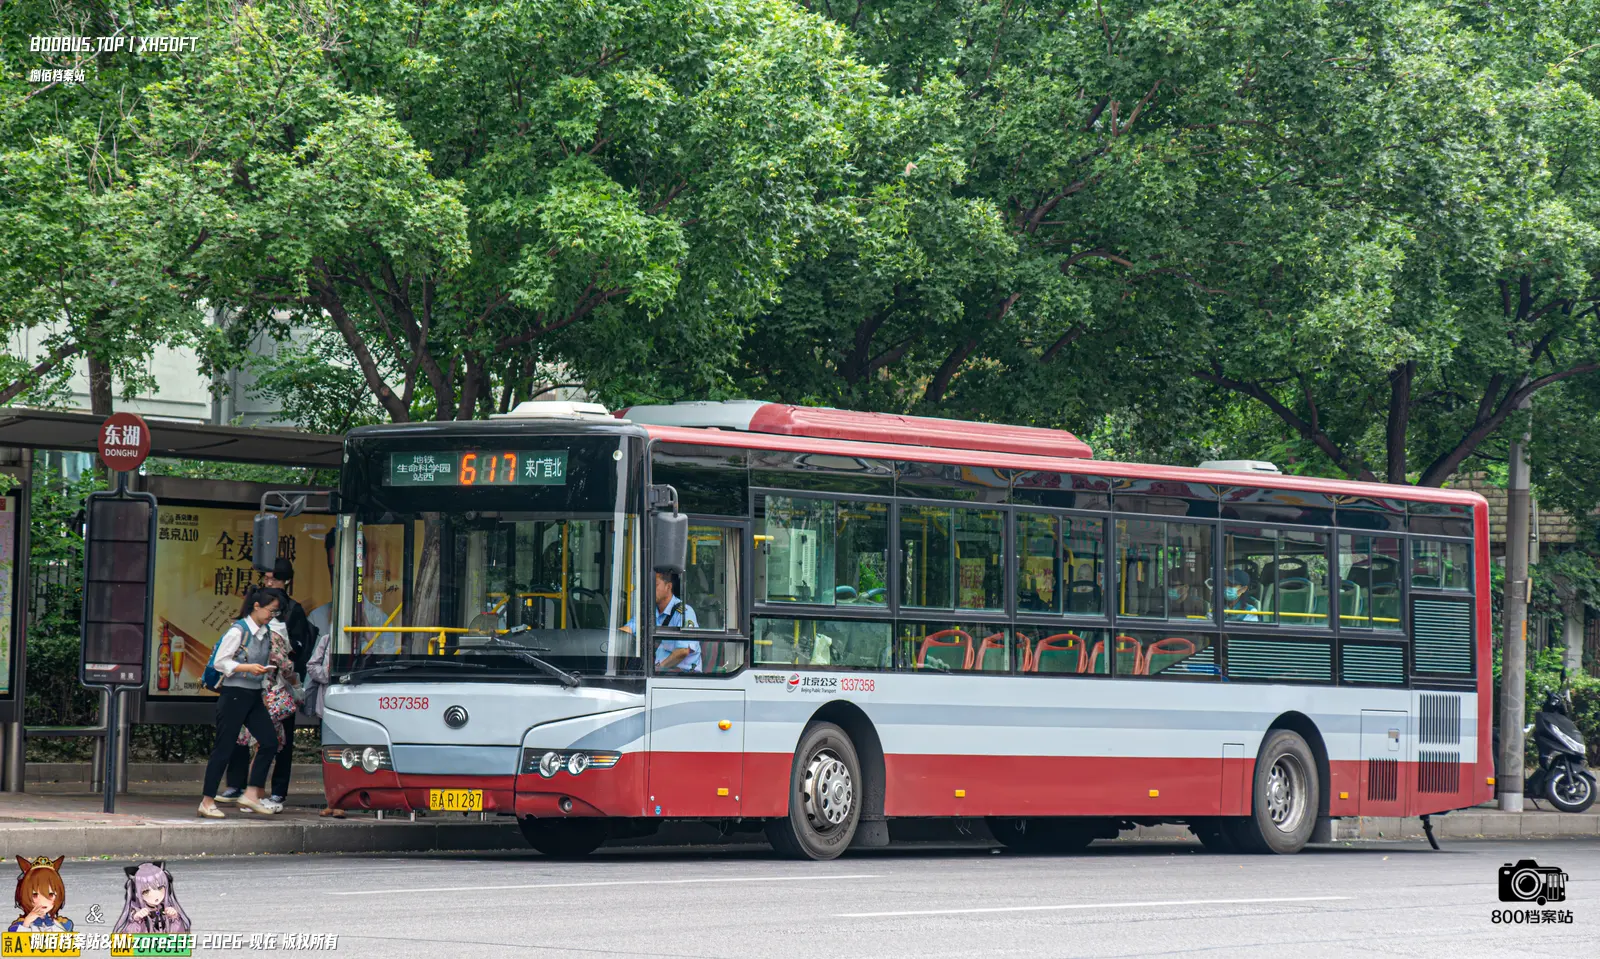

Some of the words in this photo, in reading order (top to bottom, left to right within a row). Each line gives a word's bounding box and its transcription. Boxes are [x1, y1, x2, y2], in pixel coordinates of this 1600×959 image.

[104, 424, 140, 446] 东湖
[105, 448, 138, 457] DONGHU
[413, 455, 435, 464] 地铁
[397, 463, 451, 473] 生命科学园
[460, 453, 517, 486] 617
[525, 457, 562, 478] 来广营北
[412, 473, 435, 482] 站西
[159, 527, 199, 541] 燕京A10
[216, 530, 296, 562] 全麦酿
[802, 676, 837, 687] 北京公交
[841, 678, 875, 691] 1337358
[379, 697, 429, 709] 1337358
